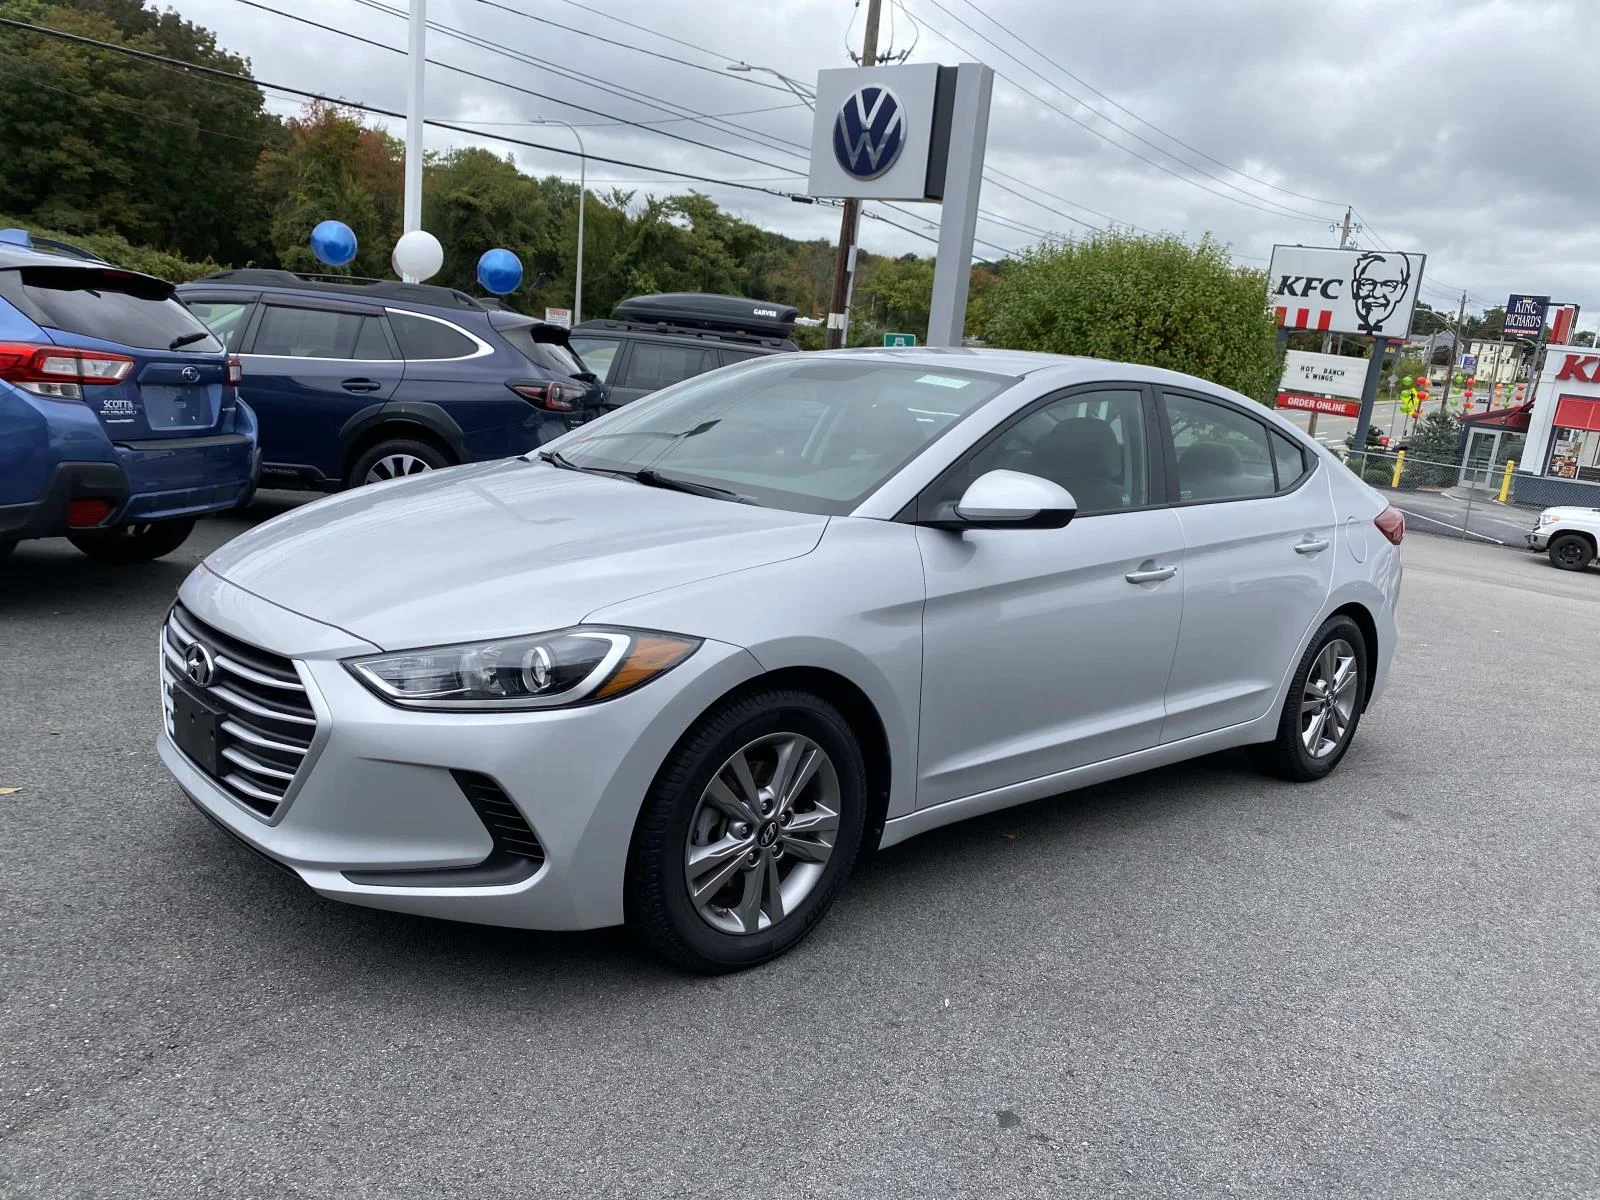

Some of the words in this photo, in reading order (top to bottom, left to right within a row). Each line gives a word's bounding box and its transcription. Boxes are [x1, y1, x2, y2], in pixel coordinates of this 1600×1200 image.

[1273, 275, 1343, 299] KFC
[1514, 300, 1537, 314] KING
[1505, 313, 1541, 328] RICHARD'S
[1300, 365, 1315, 373] HOT
[1323, 368, 1345, 377] RANCH
[1312, 373, 1334, 382] WINGS
[1287, 397, 1316, 409] ORDER
[1316, 401, 1347, 413] ONLINE
